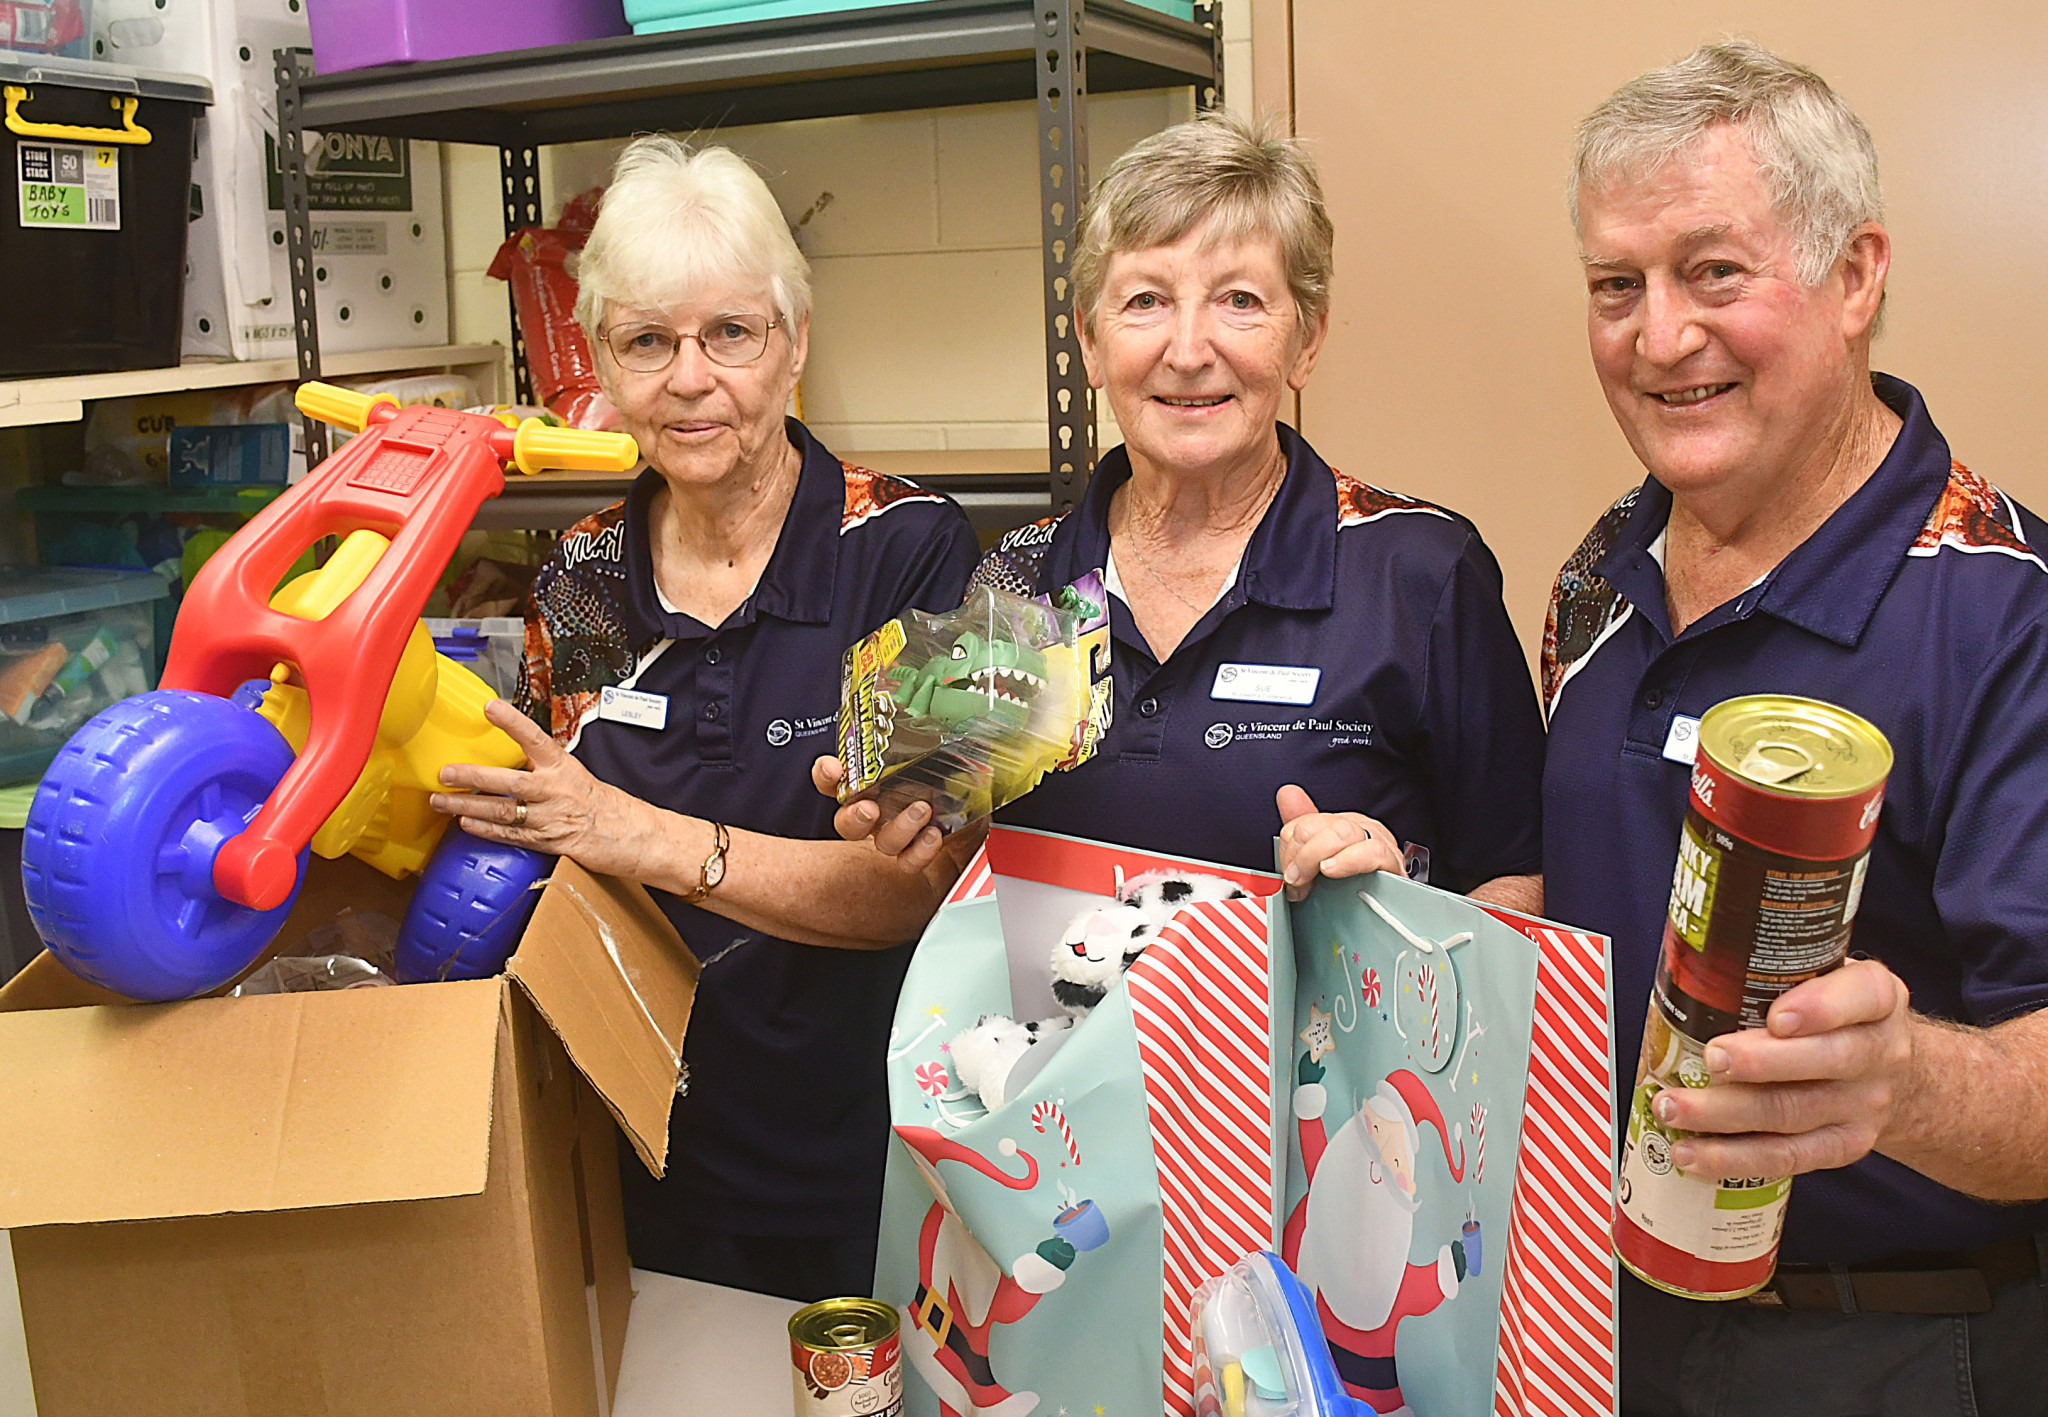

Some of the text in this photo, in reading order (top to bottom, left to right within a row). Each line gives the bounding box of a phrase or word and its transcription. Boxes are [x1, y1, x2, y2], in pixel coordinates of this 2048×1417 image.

[25, 150, 48, 161] STORE
[62, 154, 78, 170] 50
[26, 167, 49, 179] STACK
[29, 185, 67, 203] BABY
[30, 204, 70, 219] TOYS
[621, 709, 642, 719] LESLEY
[795, 711, 838, 729] St Vincent d
[858, 674, 881, 782] UNTAMED
[1236, 719, 1374, 735] St Vincent de Paul Society
[1081, 716, 1097, 756] CAUTION
[1328, 736, 1372, 748] good works
[846, 735, 857, 791] CHOMP
[1681, 823, 1713, 877] NKY
[1673, 859, 1707, 918] AM
